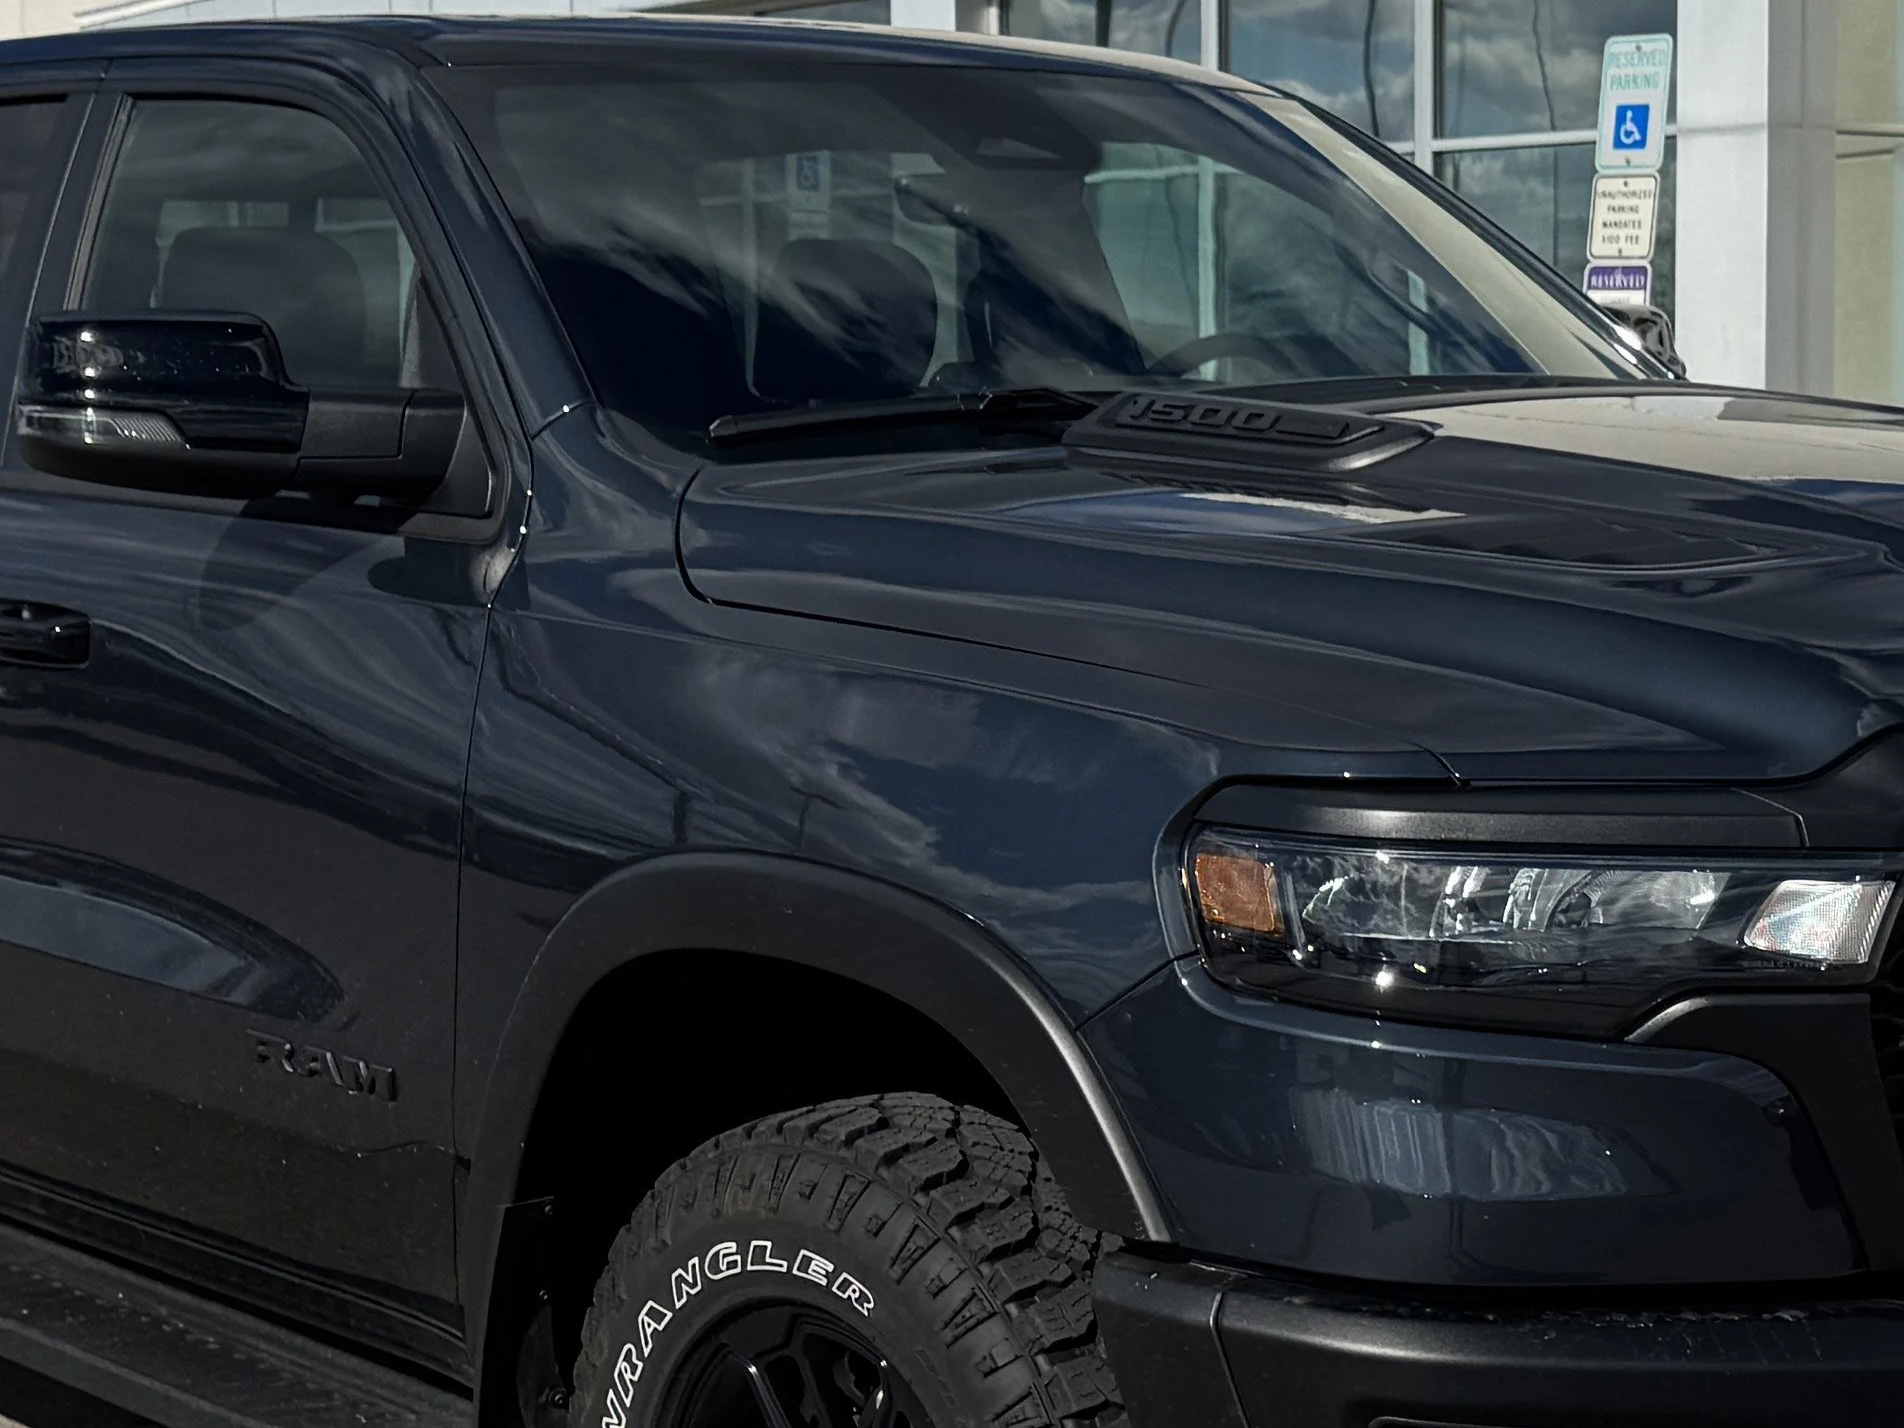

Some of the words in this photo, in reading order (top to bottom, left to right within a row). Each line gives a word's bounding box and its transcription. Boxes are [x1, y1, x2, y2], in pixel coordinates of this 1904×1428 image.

[1610, 72, 1660, 91] PARKING
[1126, 397, 1282, 432] 1500
[244, 1028, 398, 1102] RAM
